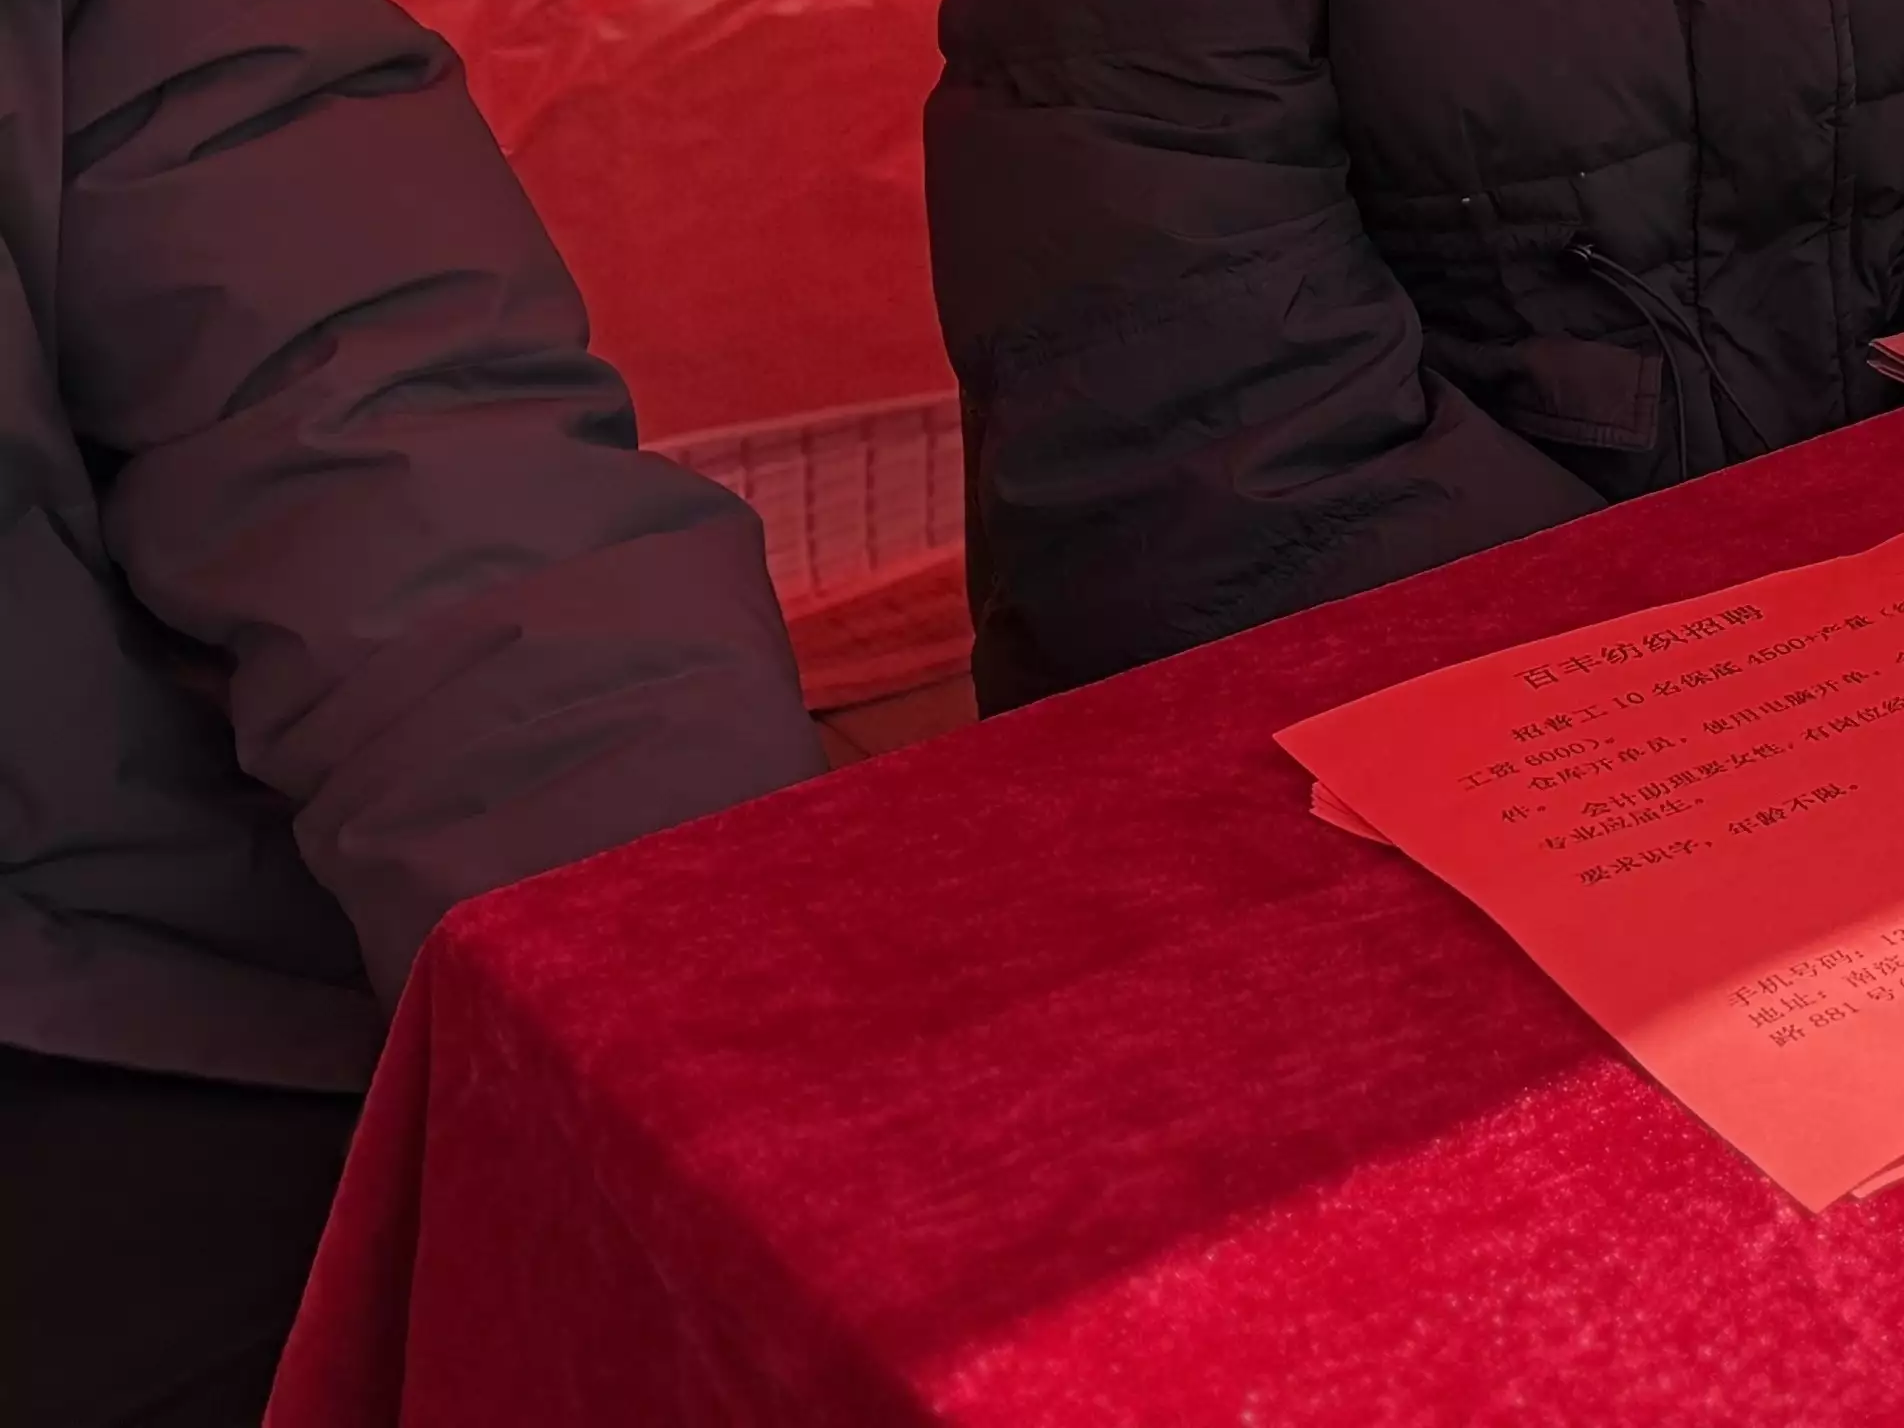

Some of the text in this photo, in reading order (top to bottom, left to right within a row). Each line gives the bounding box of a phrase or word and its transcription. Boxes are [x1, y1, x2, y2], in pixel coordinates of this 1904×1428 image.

[1513, 603, 1764, 690] 百丰纺织招聘
